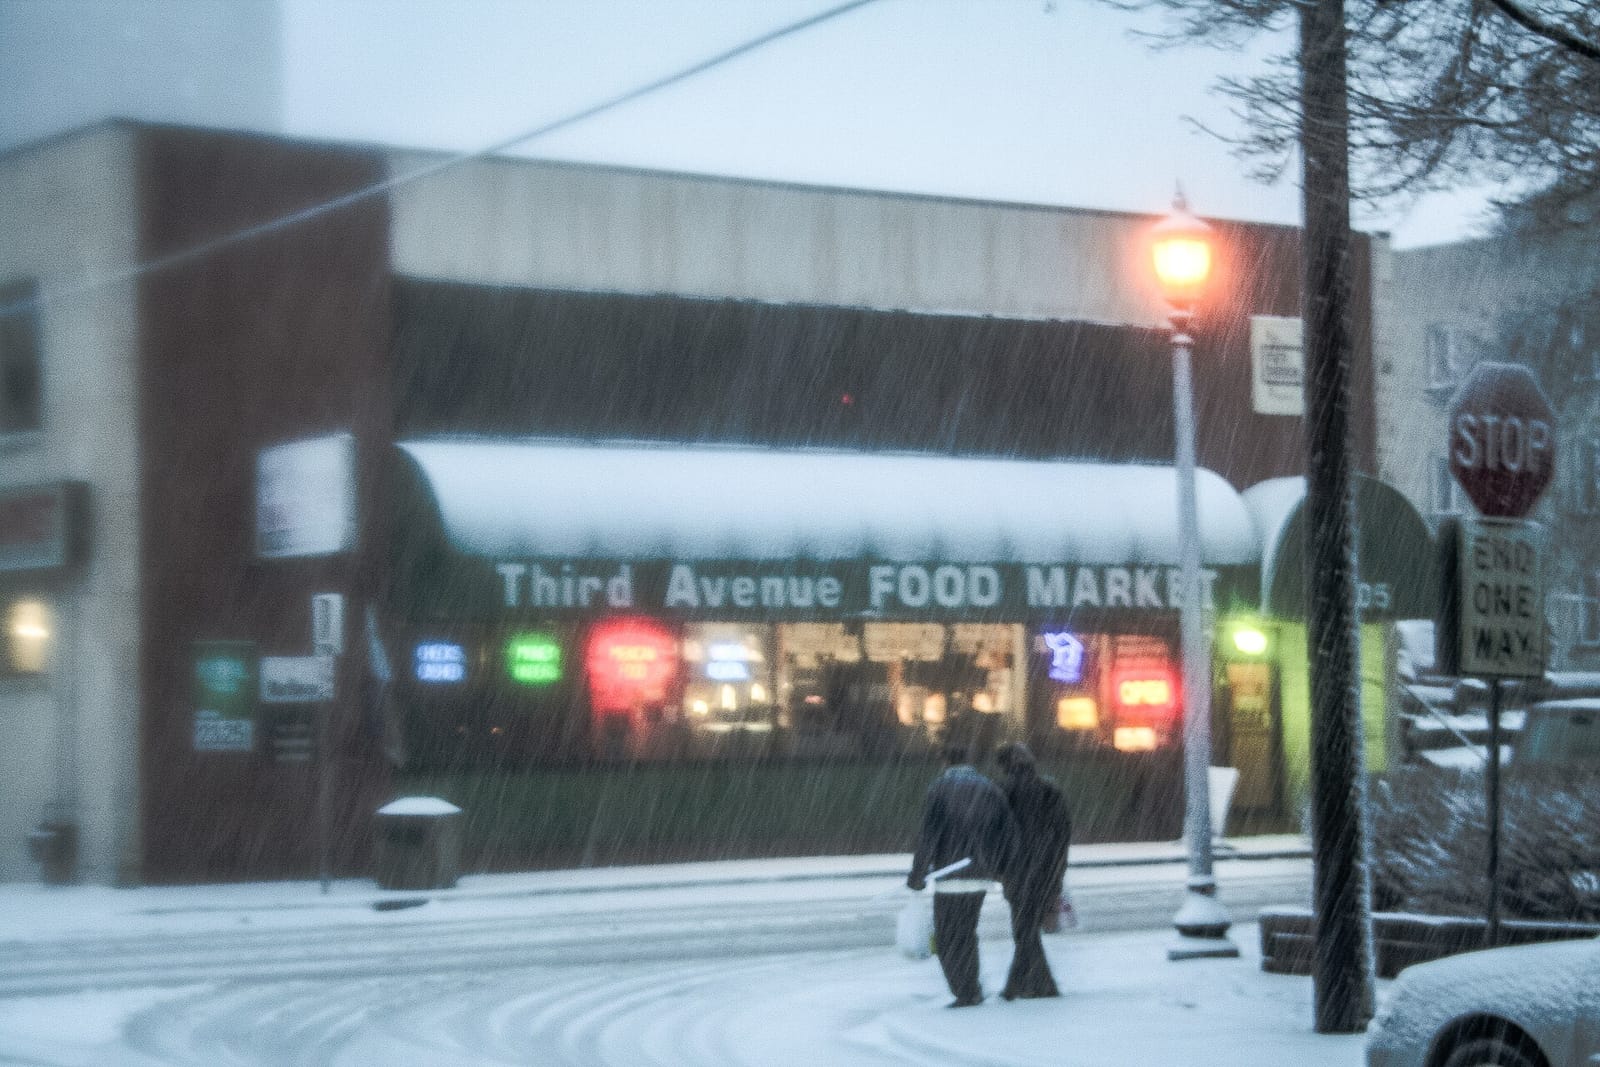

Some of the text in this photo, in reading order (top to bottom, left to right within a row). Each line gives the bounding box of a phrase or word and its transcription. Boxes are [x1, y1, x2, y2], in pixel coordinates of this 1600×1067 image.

[1456, 413, 1551, 472] STOP
[1474, 536, 1535, 573] END
[496, 562, 635, 608] Third
[664, 564, 843, 608] Avenue
[869, 564, 1000, 609] FOOD
[1474, 582, 1533, 618] ONE
[1473, 626, 1530, 660] WAY
